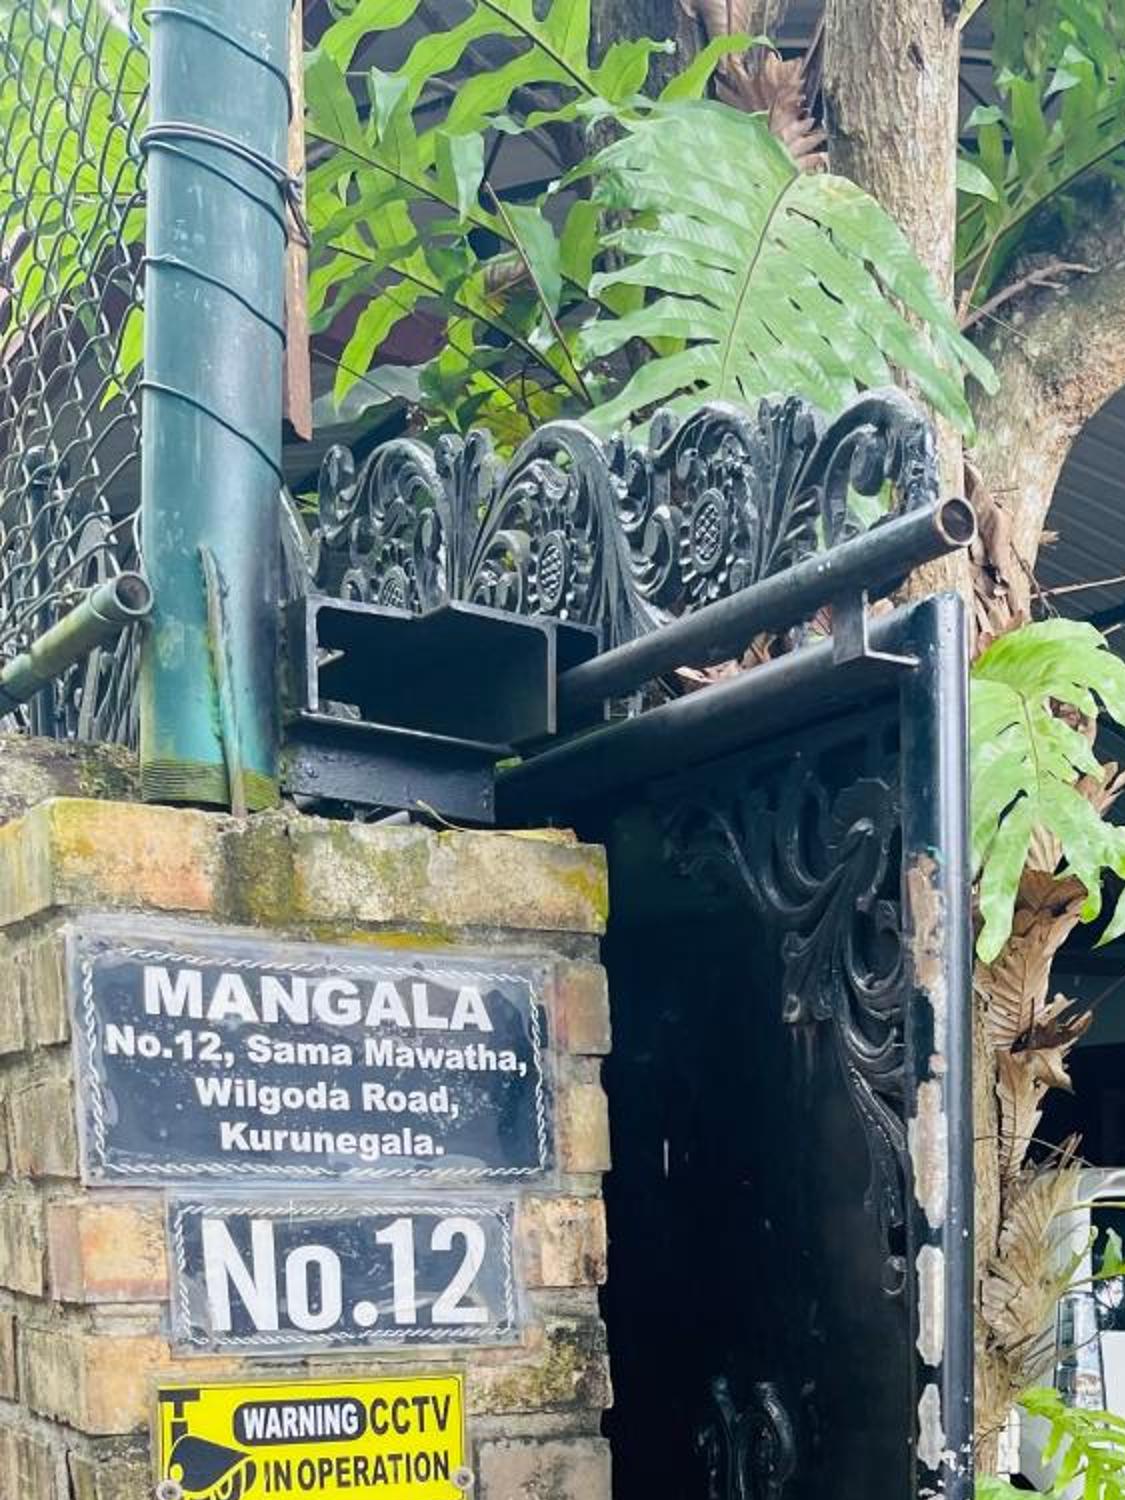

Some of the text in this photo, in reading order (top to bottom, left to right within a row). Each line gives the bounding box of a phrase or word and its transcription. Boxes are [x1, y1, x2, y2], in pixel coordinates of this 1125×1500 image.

[143, 966, 494, 1032] MANGALA
[106, 1025, 528, 1077] No.12, Sama Mawatha,
[195, 1077, 460, 1118] Wilgoda Road,
[220, 1122, 445, 1160] Kurunegala.
[202, 1216, 489, 1332] No.12
[243, 1394, 451, 1440] WARNING CCTV
[264, 1450, 450, 1493] IN OPERATION
